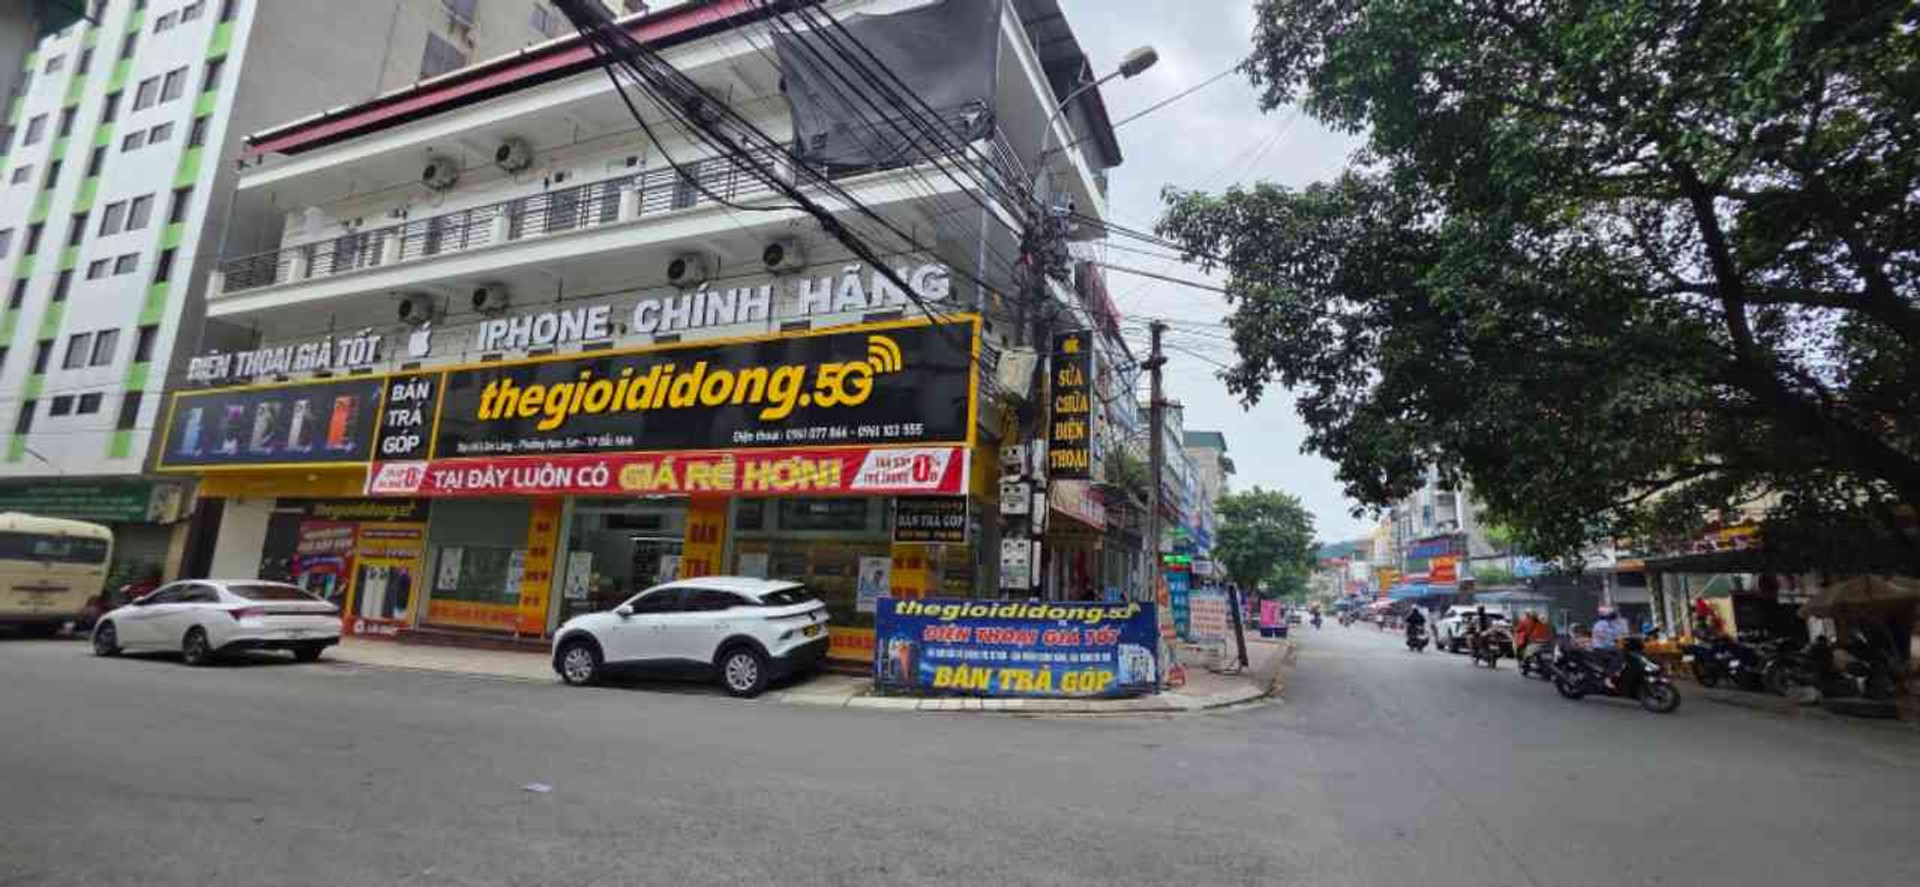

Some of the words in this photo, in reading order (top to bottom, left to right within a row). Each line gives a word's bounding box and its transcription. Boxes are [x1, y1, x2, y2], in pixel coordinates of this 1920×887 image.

[477, 304, 613, 352] IPHONE
[633, 281, 771, 334] CHÍNH
[293, 336, 333, 372] GIÁ
[334, 327, 382, 368] TỐT
[391, 377, 430, 402] BÁN
[477, 358, 873, 432] thegioididong.5G
[387, 404, 424, 428] TRẢ
[383, 431, 421, 455] GÓP
[433, 469, 464, 493] TẠI
[467, 464, 510, 489] ĐÂY
[512, 461, 570, 488] LUÔN
[576, 460, 609, 488] CÓ
[618, 454, 680, 491] GIÁ
[932, 664, 991, 690] BÁN
[1060, 666, 1116, 694] GÓP
